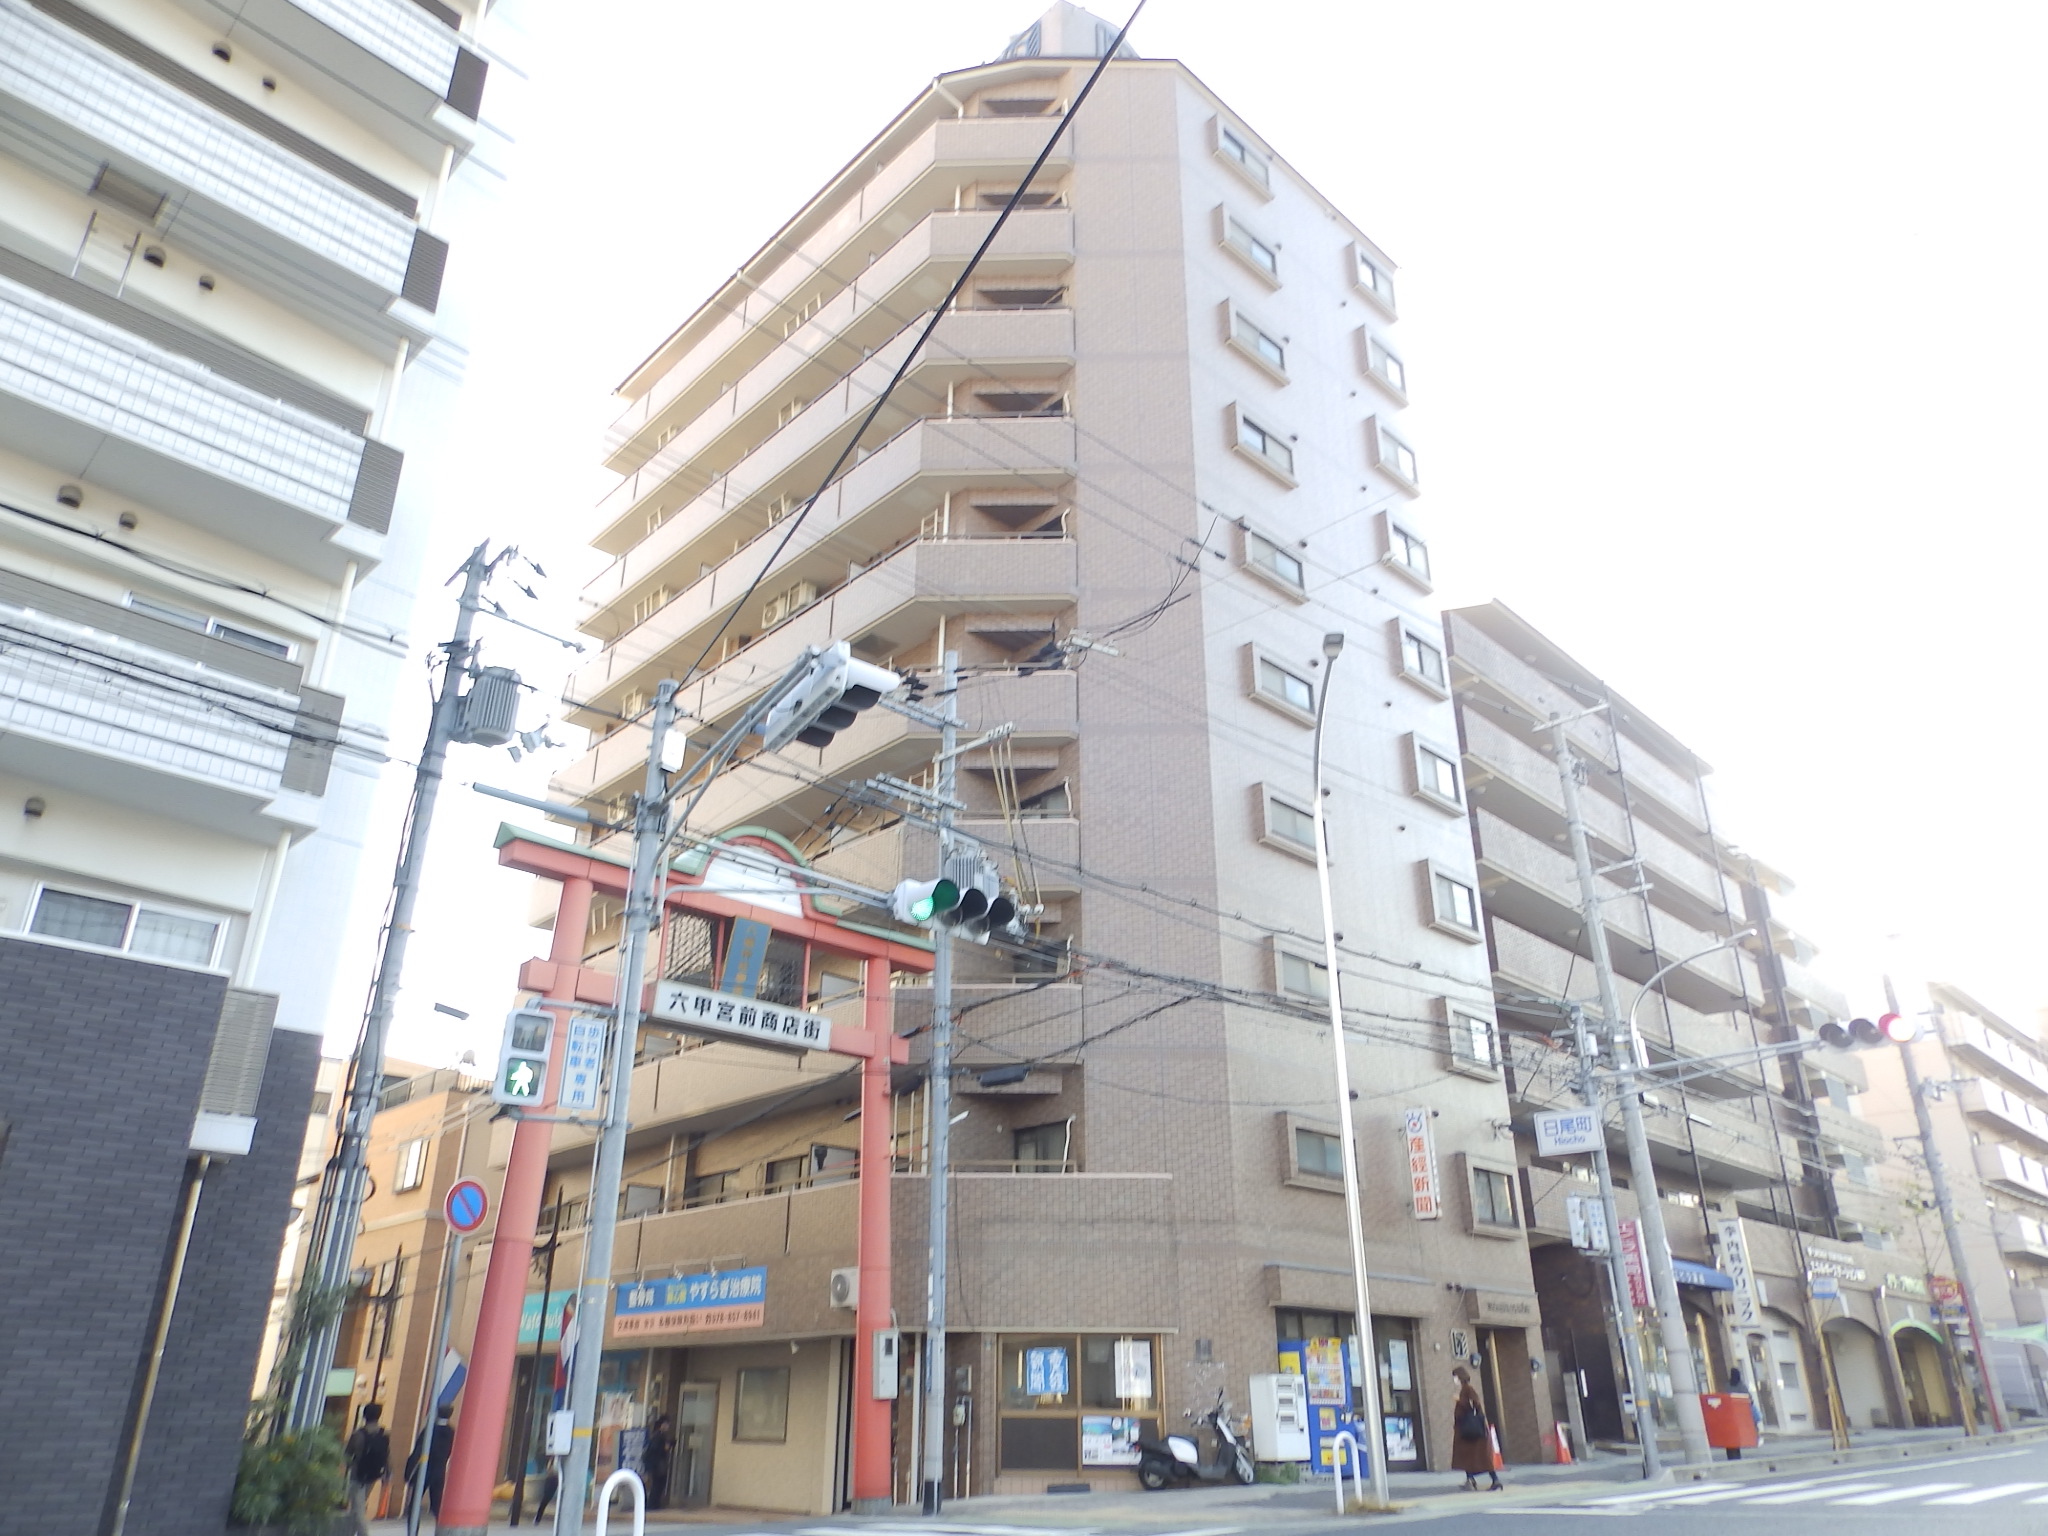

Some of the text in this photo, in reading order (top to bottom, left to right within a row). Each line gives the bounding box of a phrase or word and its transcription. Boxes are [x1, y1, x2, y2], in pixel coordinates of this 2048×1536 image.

[668, 990, 822, 1041] 六甲宮前商店街
[1543, 1116, 1592, 1137] 日尾町
[689, 1274, 762, 1302] やすらぎ治療院
